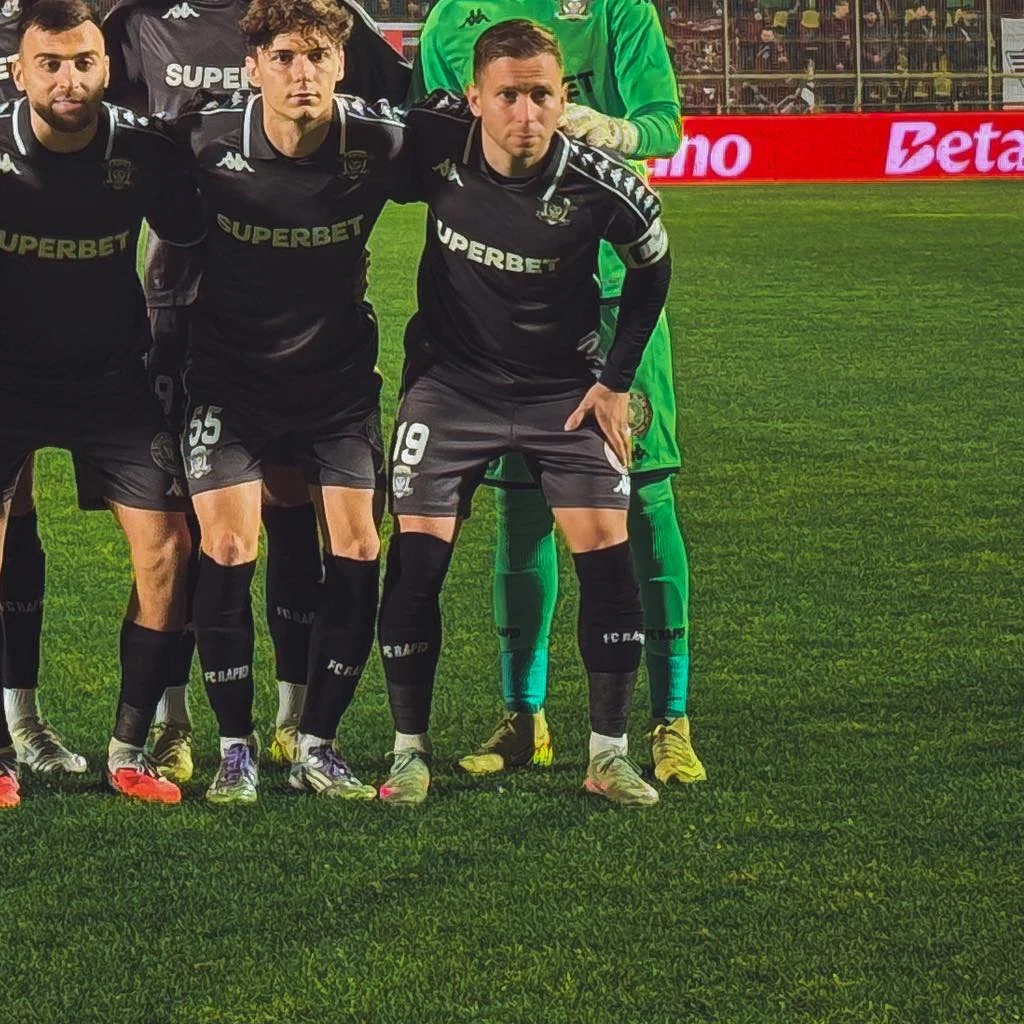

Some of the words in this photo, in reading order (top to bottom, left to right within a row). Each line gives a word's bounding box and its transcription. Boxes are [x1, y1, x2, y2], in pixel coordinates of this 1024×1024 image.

[216, 213, 364, 248] SUPERBET
[189, 405, 223, 447] 55
[393, 421, 430, 465] 19
